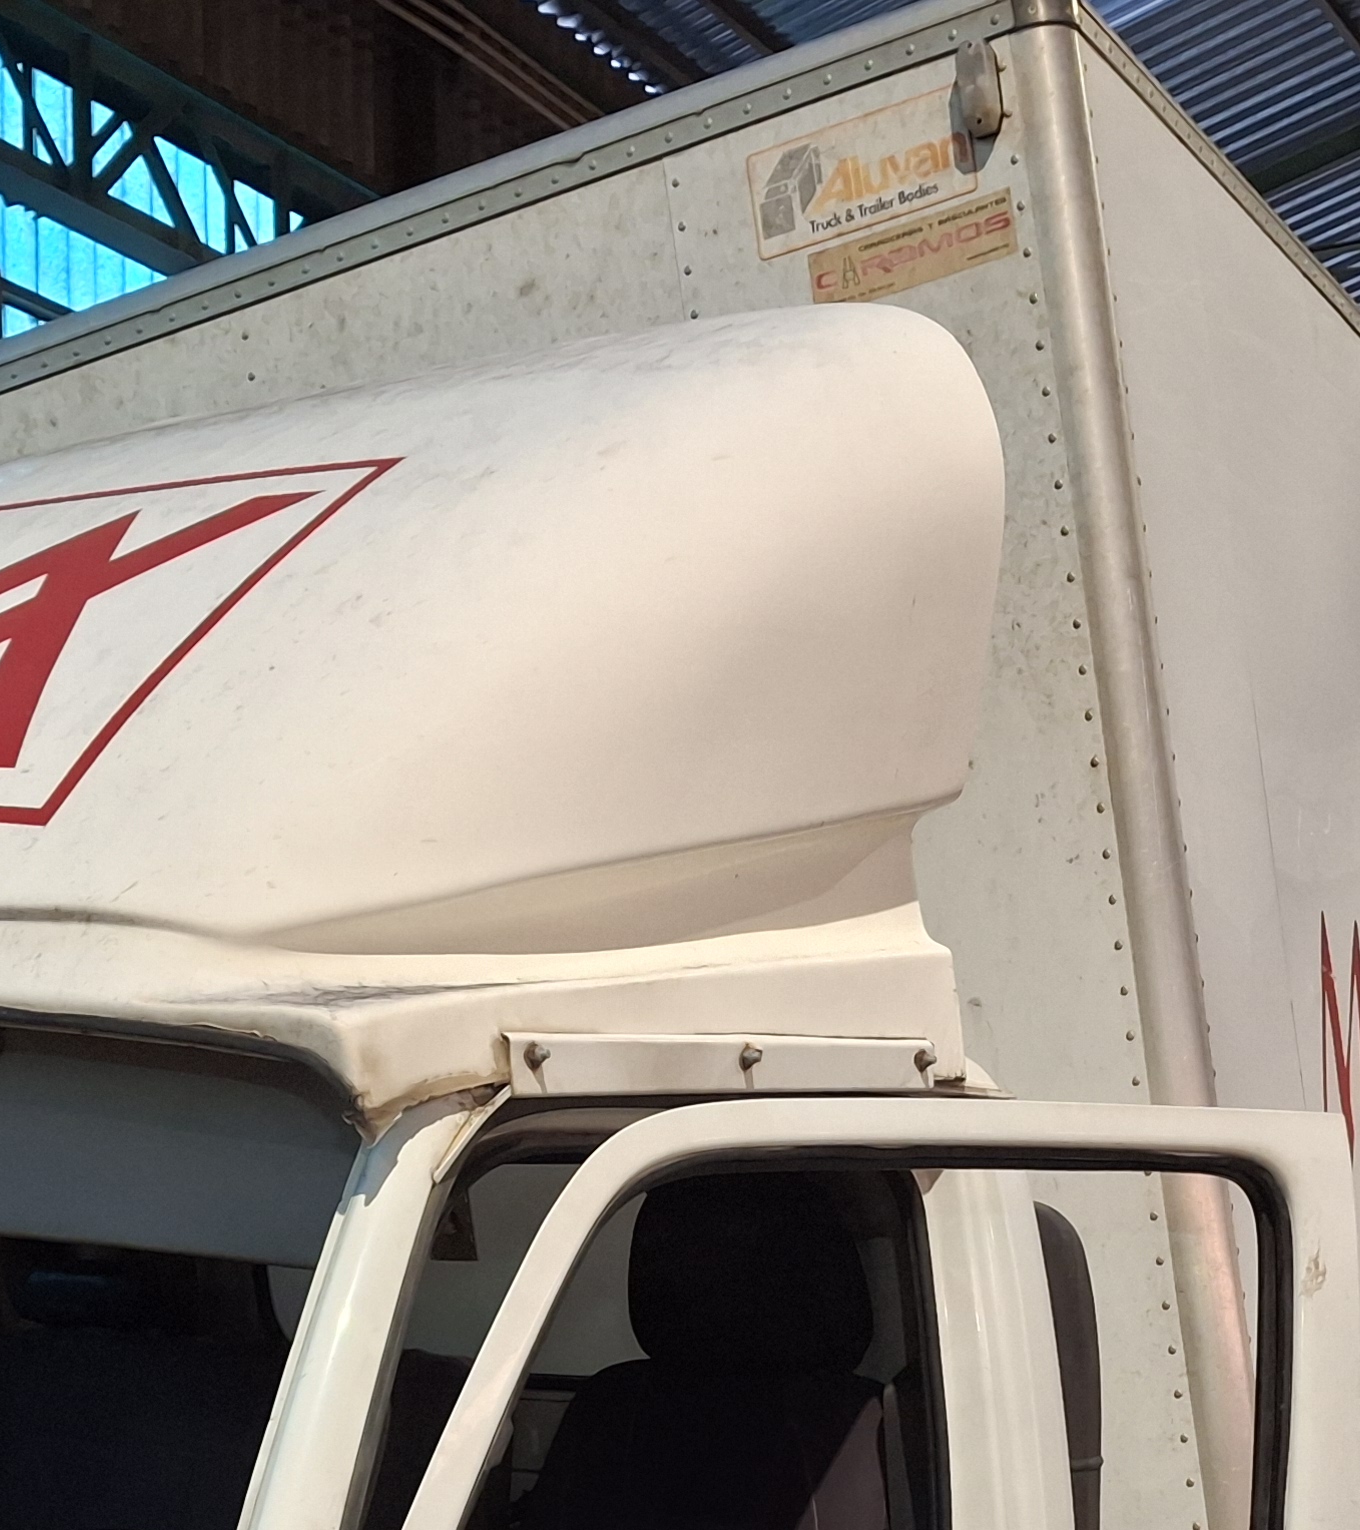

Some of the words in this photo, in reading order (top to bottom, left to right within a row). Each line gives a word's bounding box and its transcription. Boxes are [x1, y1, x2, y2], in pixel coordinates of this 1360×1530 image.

[807, 134, 972, 212] Aluvan
[809, 215, 842, 235] Truck
[844, 208, 856, 224] &
[857, 198, 894, 218] Trailer
[897, 182, 939, 205] Bodies
